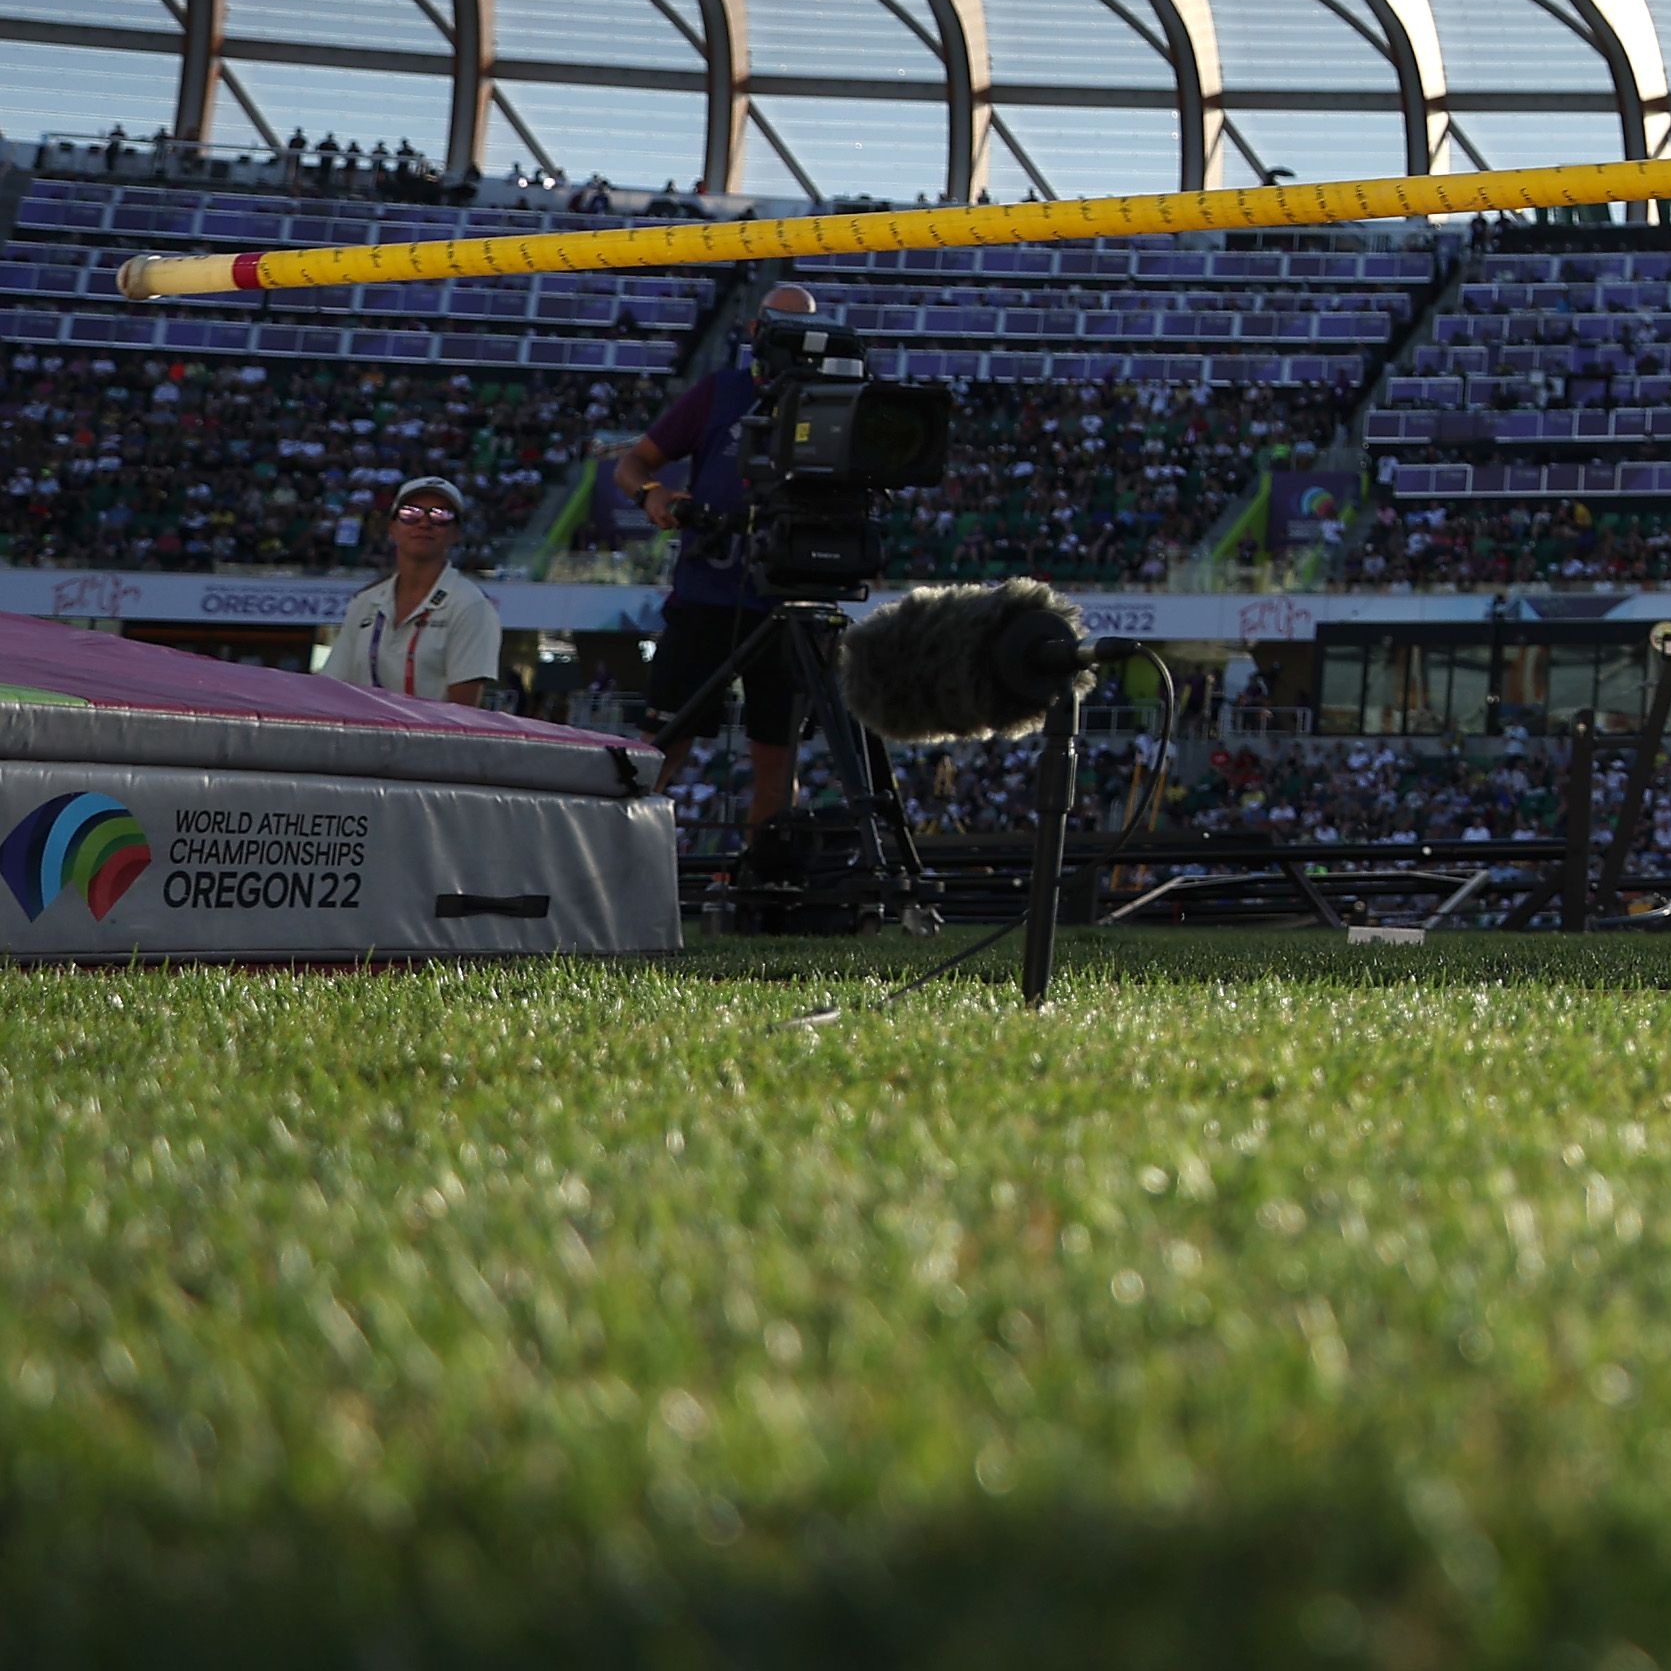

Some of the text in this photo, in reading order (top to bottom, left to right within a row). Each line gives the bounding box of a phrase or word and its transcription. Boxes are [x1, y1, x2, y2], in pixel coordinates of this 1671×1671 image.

[176, 809, 368, 837] WORLD ATHLETICS
[170, 838, 364, 866] CHAMPIONSHIPS
